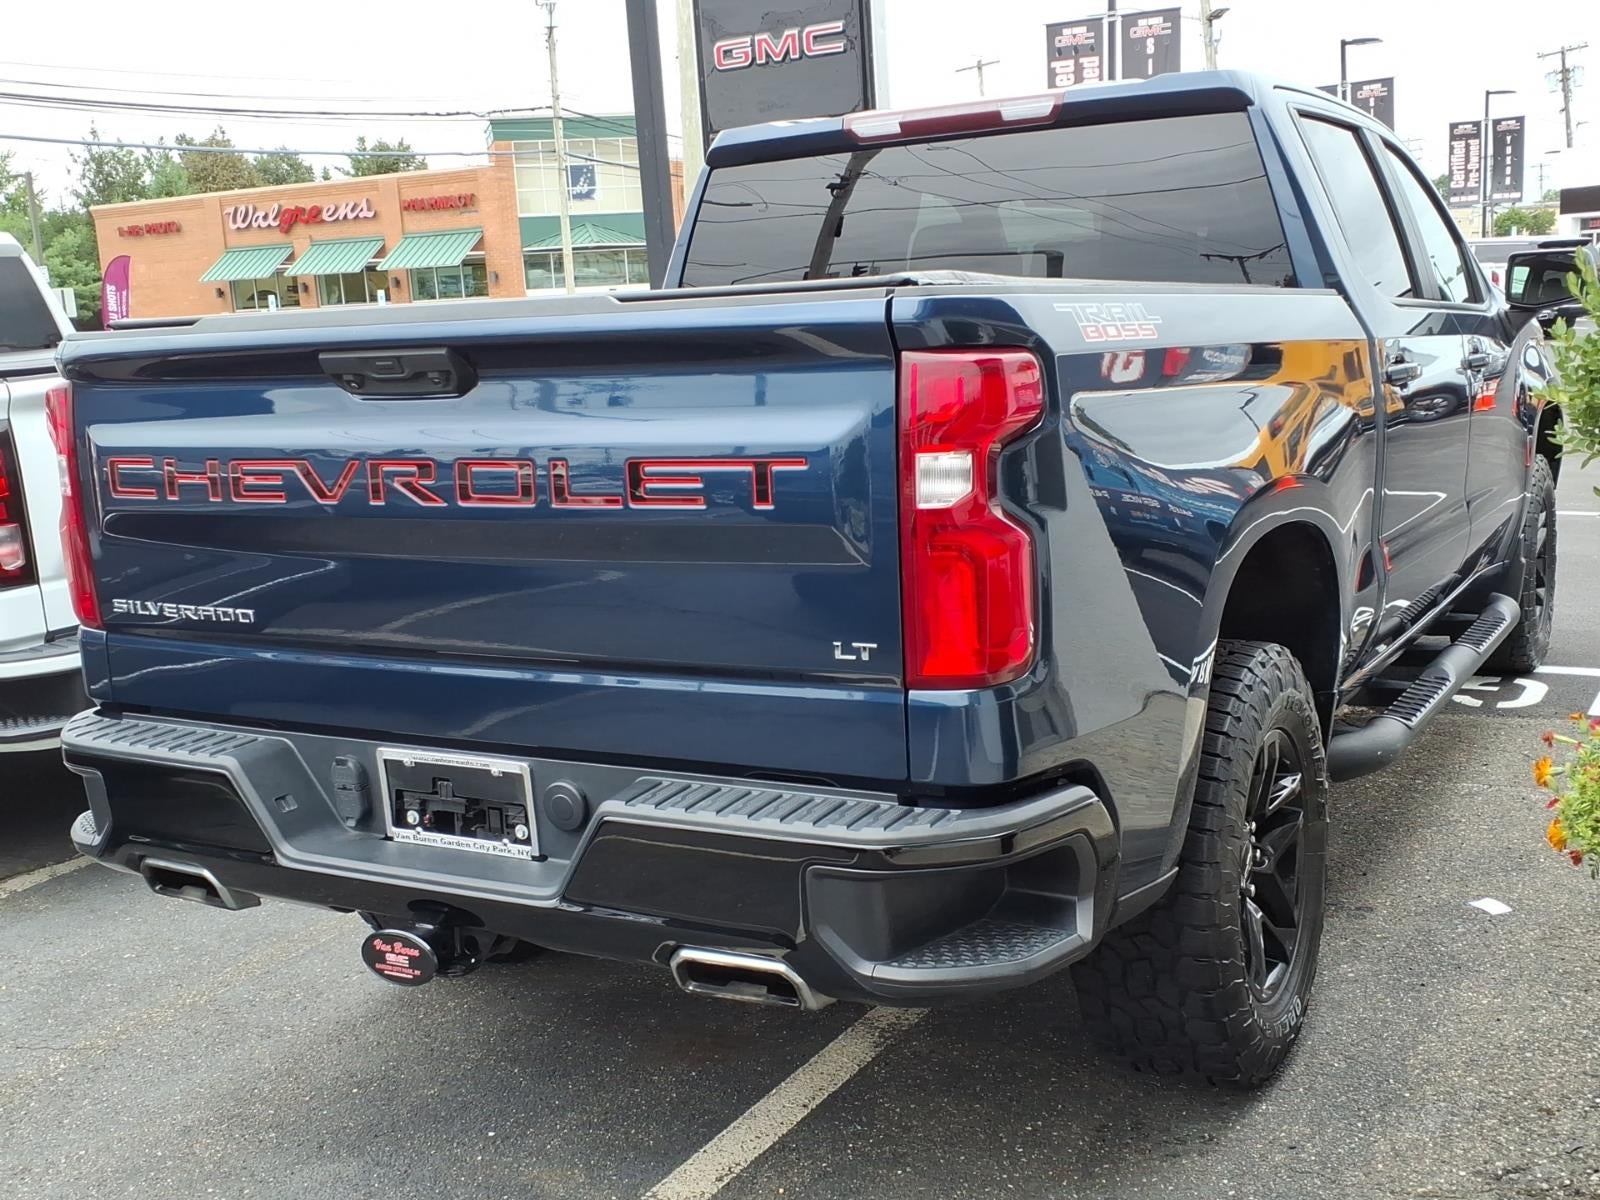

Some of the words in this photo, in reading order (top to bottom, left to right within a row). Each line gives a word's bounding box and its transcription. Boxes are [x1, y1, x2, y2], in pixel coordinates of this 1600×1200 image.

[1054, 32, 1095, 48] GMC
[1130, 22, 1172, 39] GMC
[713, 20, 846, 72] GMC
[1450, 140, 1466, 188] Certified
[1467, 138, 1480, 188] Pre-Owned
[224, 199, 375, 234] Walgreens
[1053, 303, 1162, 323] TRAIL
[1080, 323, 1158, 342] BOSS
[106, 456, 809, 511] CHEVROLET
[112, 598, 256, 624] SILVERADO
[832, 641, 878, 661] LT
[394, 831, 411, 841] Van
[440, 837, 471, 848] Garden
[473, 841, 490, 852] City
[517, 849, 531, 857] NY
